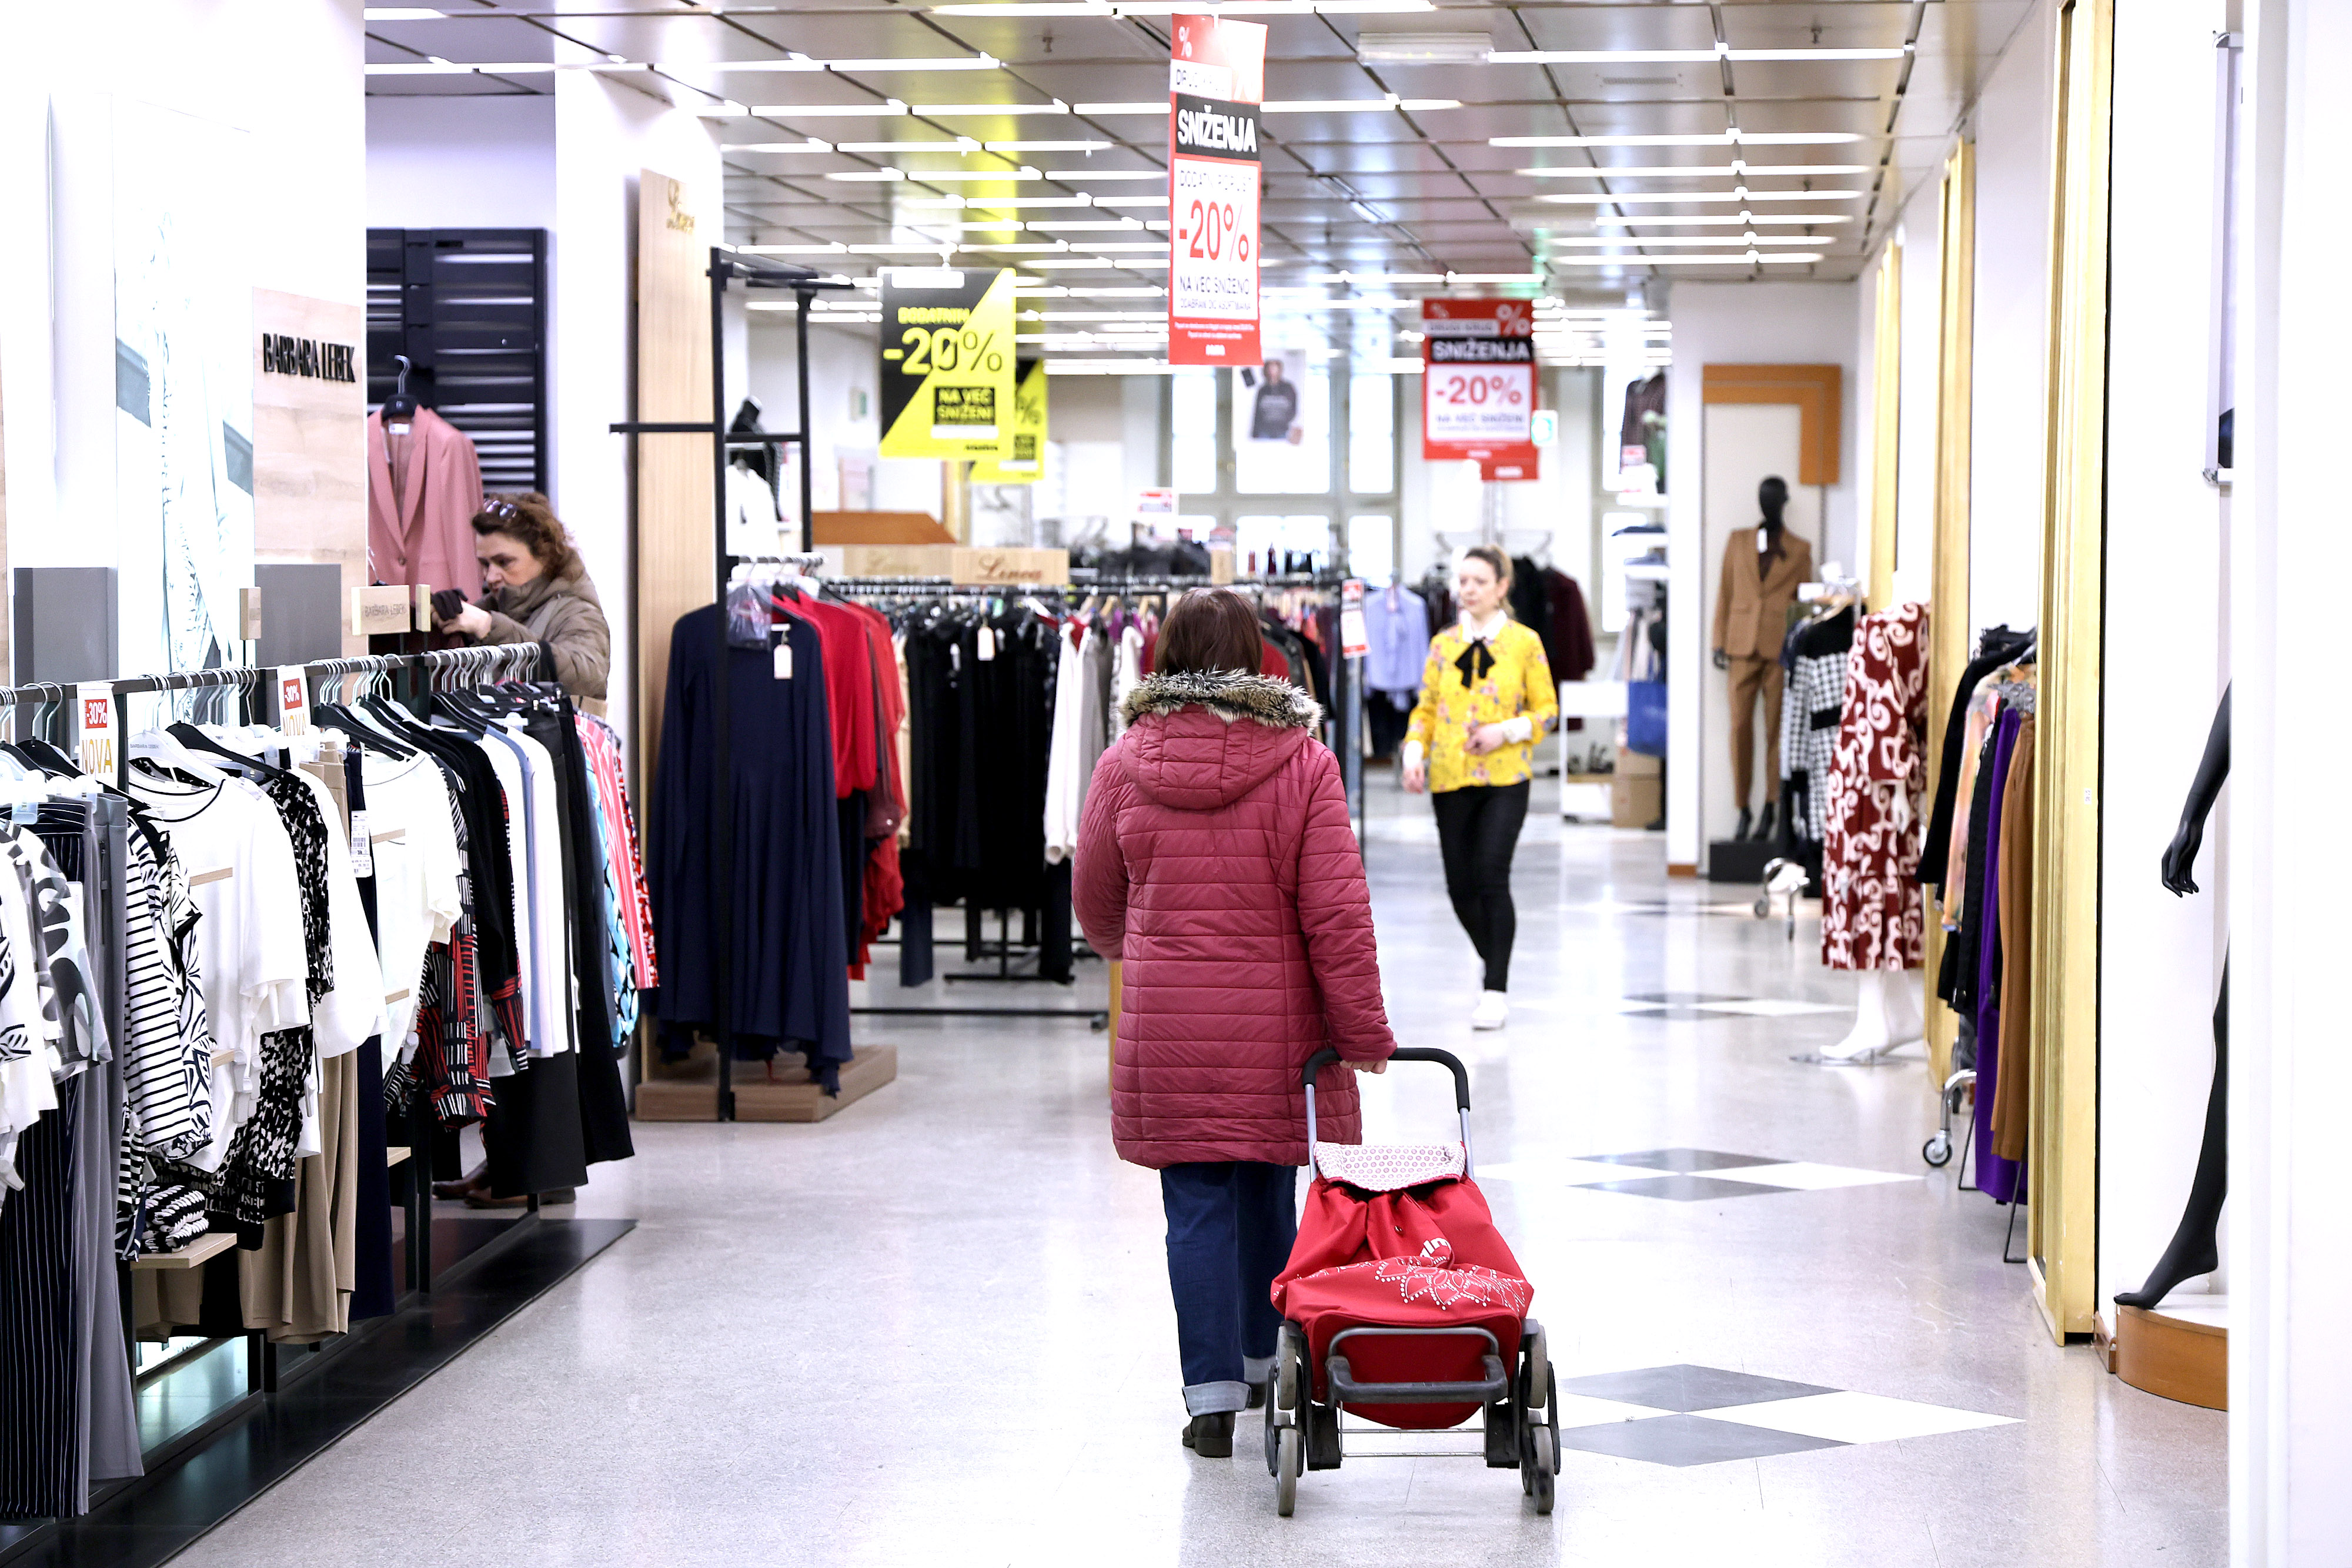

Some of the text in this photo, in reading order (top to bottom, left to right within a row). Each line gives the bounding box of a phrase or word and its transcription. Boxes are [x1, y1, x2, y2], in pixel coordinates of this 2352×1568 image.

[1177, 104, 1257, 153] SNIŽENJA
[1178, 199, 1249, 262] -20%
[263, 332, 356, 383] BARBARA LEBEK
[883, 326, 1003, 375] -20%
[1431, 336, 1530, 361] SNIŽENJA
[1435, 375, 1522, 405] -20%
[285, 684, 300, 703] -30%
[86, 701, 107, 725] -30%
[82, 738, 113, 774] NOVA
